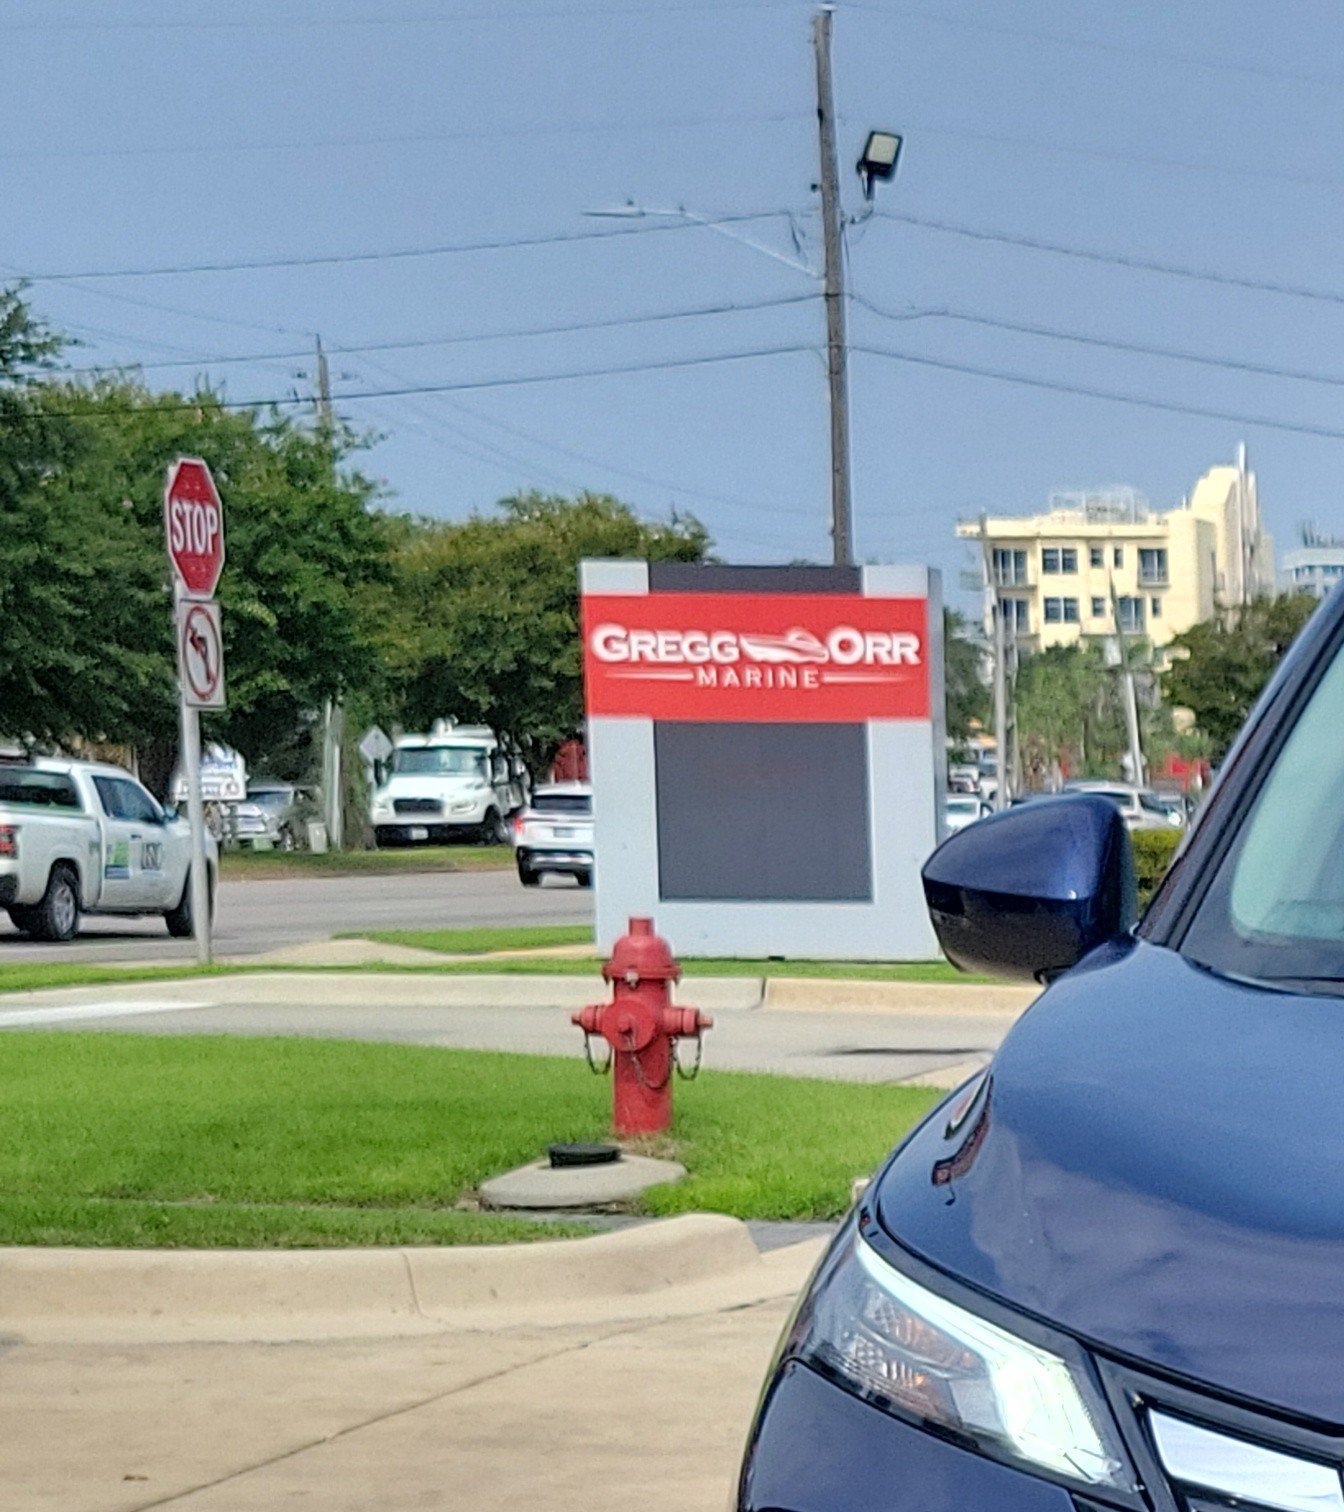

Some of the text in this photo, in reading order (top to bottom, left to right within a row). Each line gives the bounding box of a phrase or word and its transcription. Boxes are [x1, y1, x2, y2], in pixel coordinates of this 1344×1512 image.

[172, 501, 218, 554] STOP
[590, 624, 921, 664] GREGG ORR
[696, 667, 820, 689] MARINE
